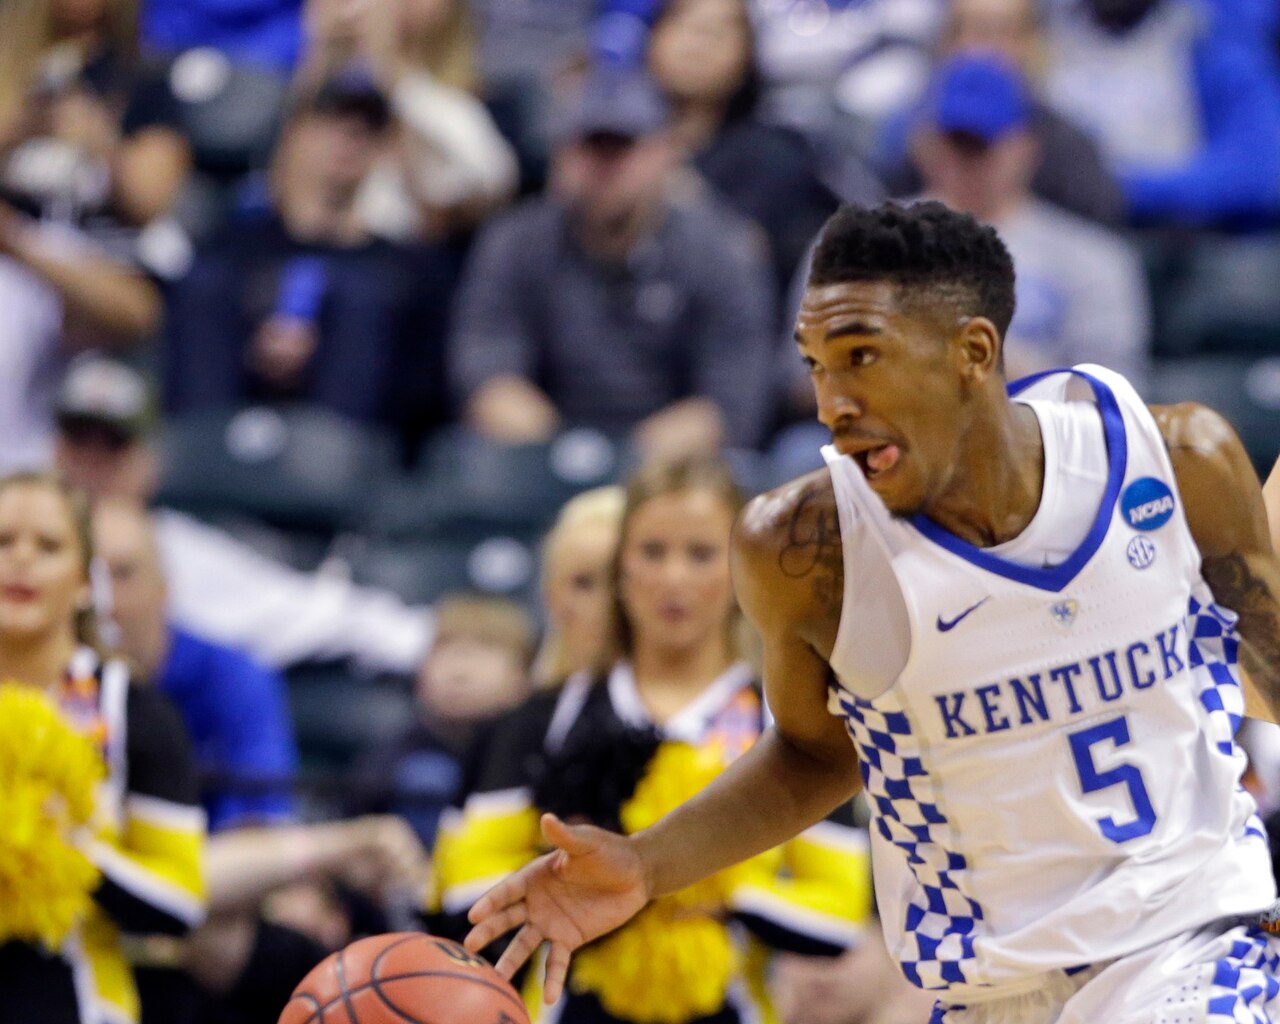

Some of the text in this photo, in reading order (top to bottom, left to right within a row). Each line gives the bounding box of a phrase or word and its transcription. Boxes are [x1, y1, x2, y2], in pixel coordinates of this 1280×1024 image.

[1129, 494, 1174, 525] NCAA
[935, 618, 1195, 739] KENTUCK
[1066, 715, 1158, 844] 5
